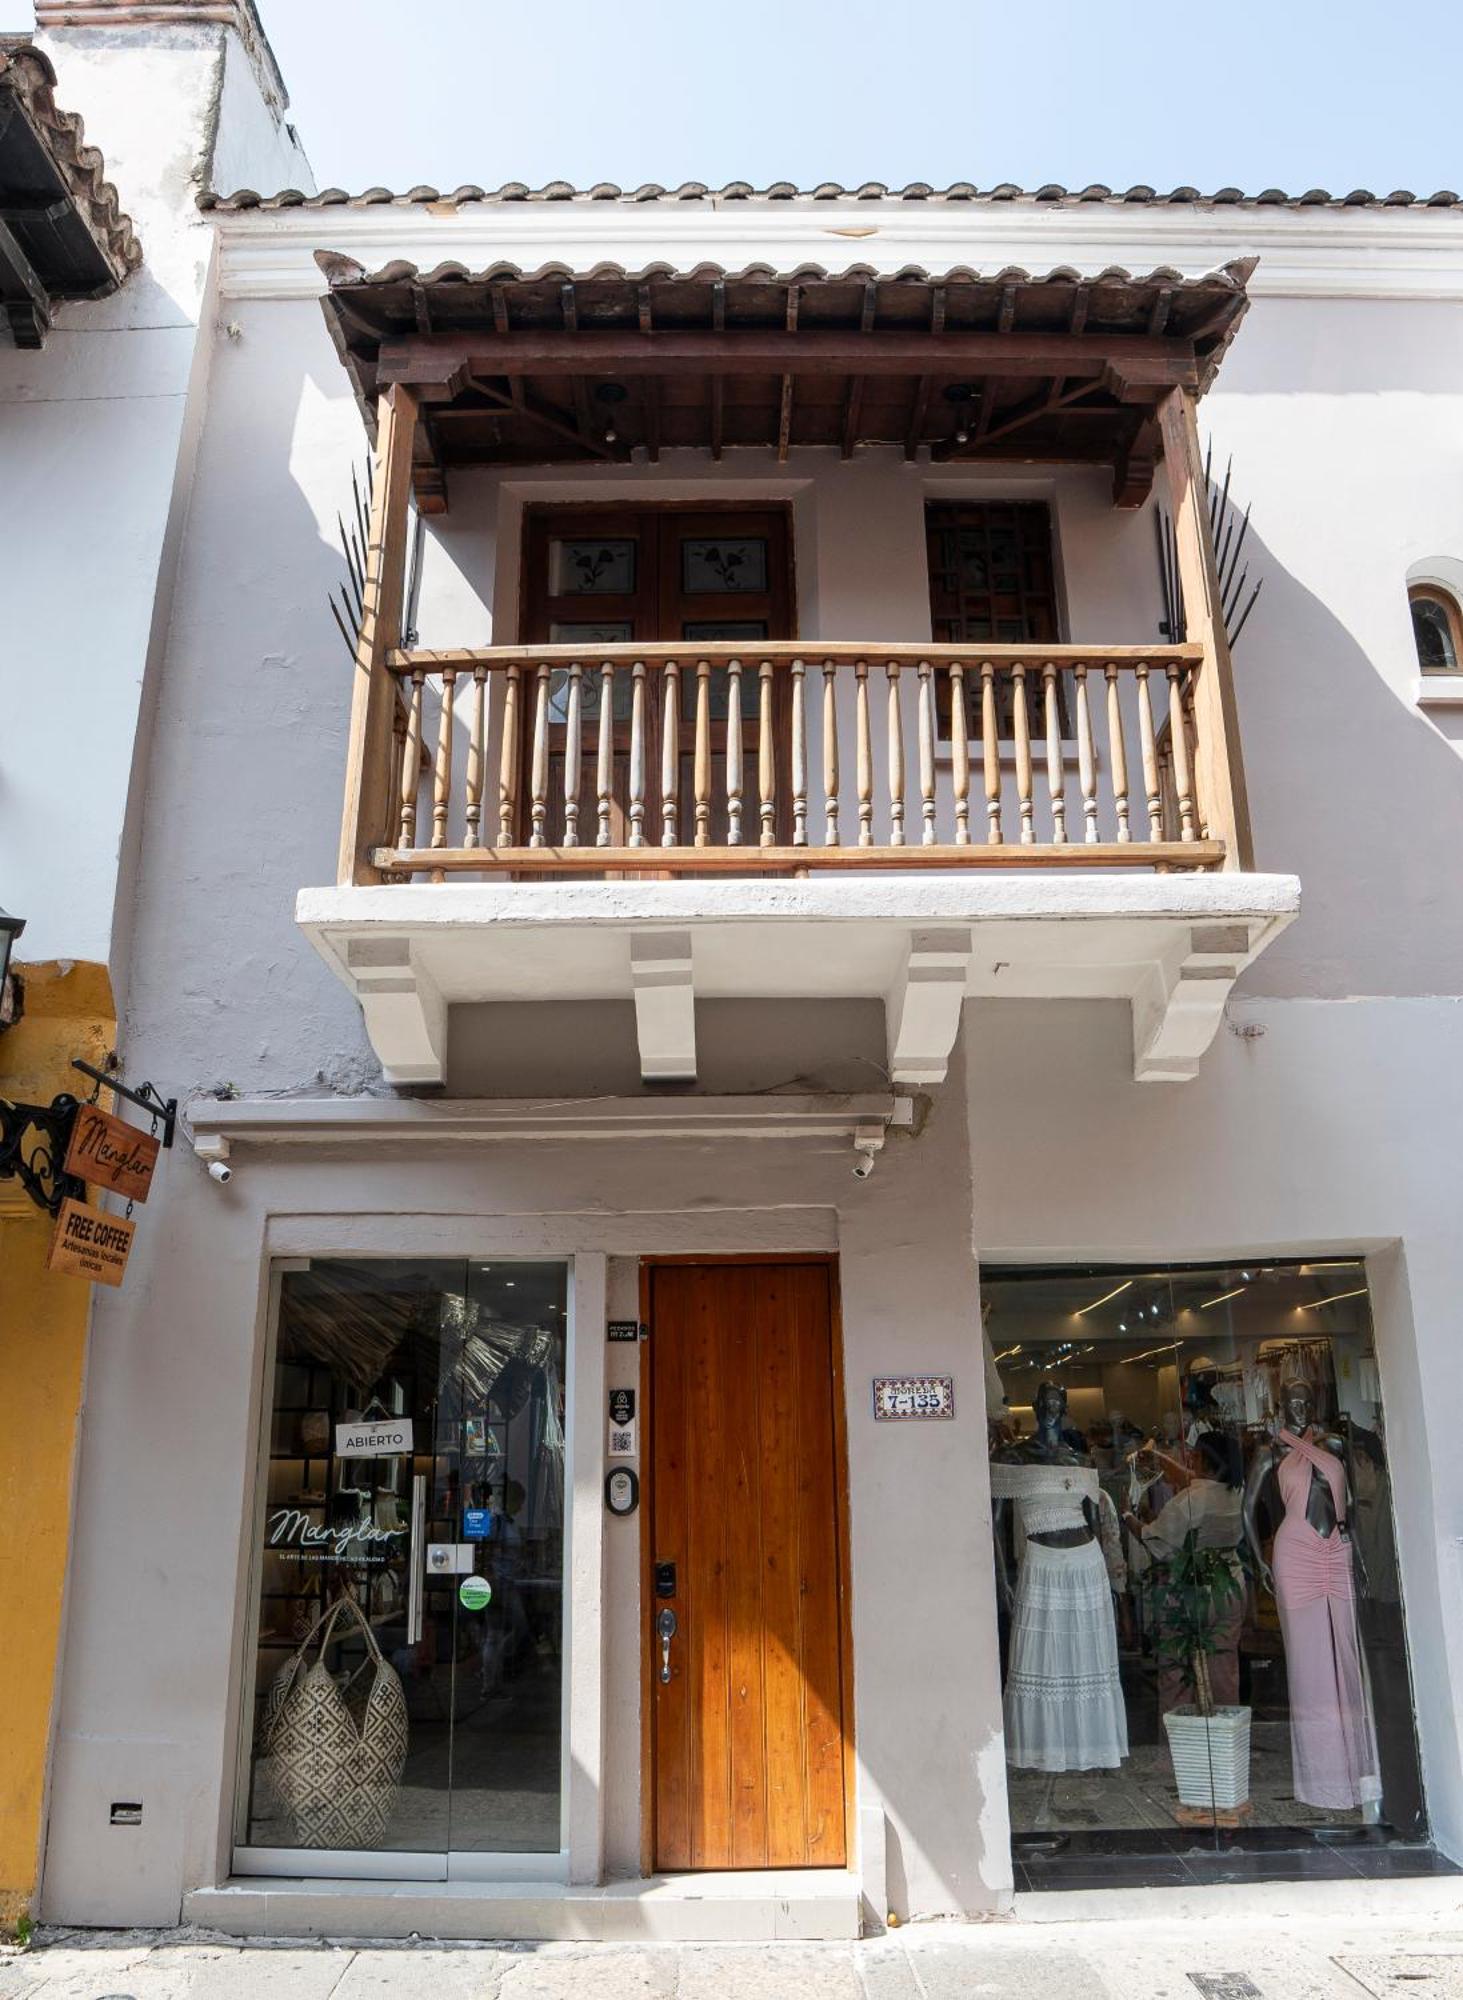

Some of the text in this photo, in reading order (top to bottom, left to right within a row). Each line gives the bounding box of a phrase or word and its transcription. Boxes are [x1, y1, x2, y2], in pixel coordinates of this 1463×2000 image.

[78, 1116, 151, 1182] Manglar
[65, 1213, 130, 1253] FREE COFFEE
[888, 1394, 941, 1409] 7-135
[346, 1434, 404, 1448] ABIERTO
[268, 1509, 405, 1554] Manglar
